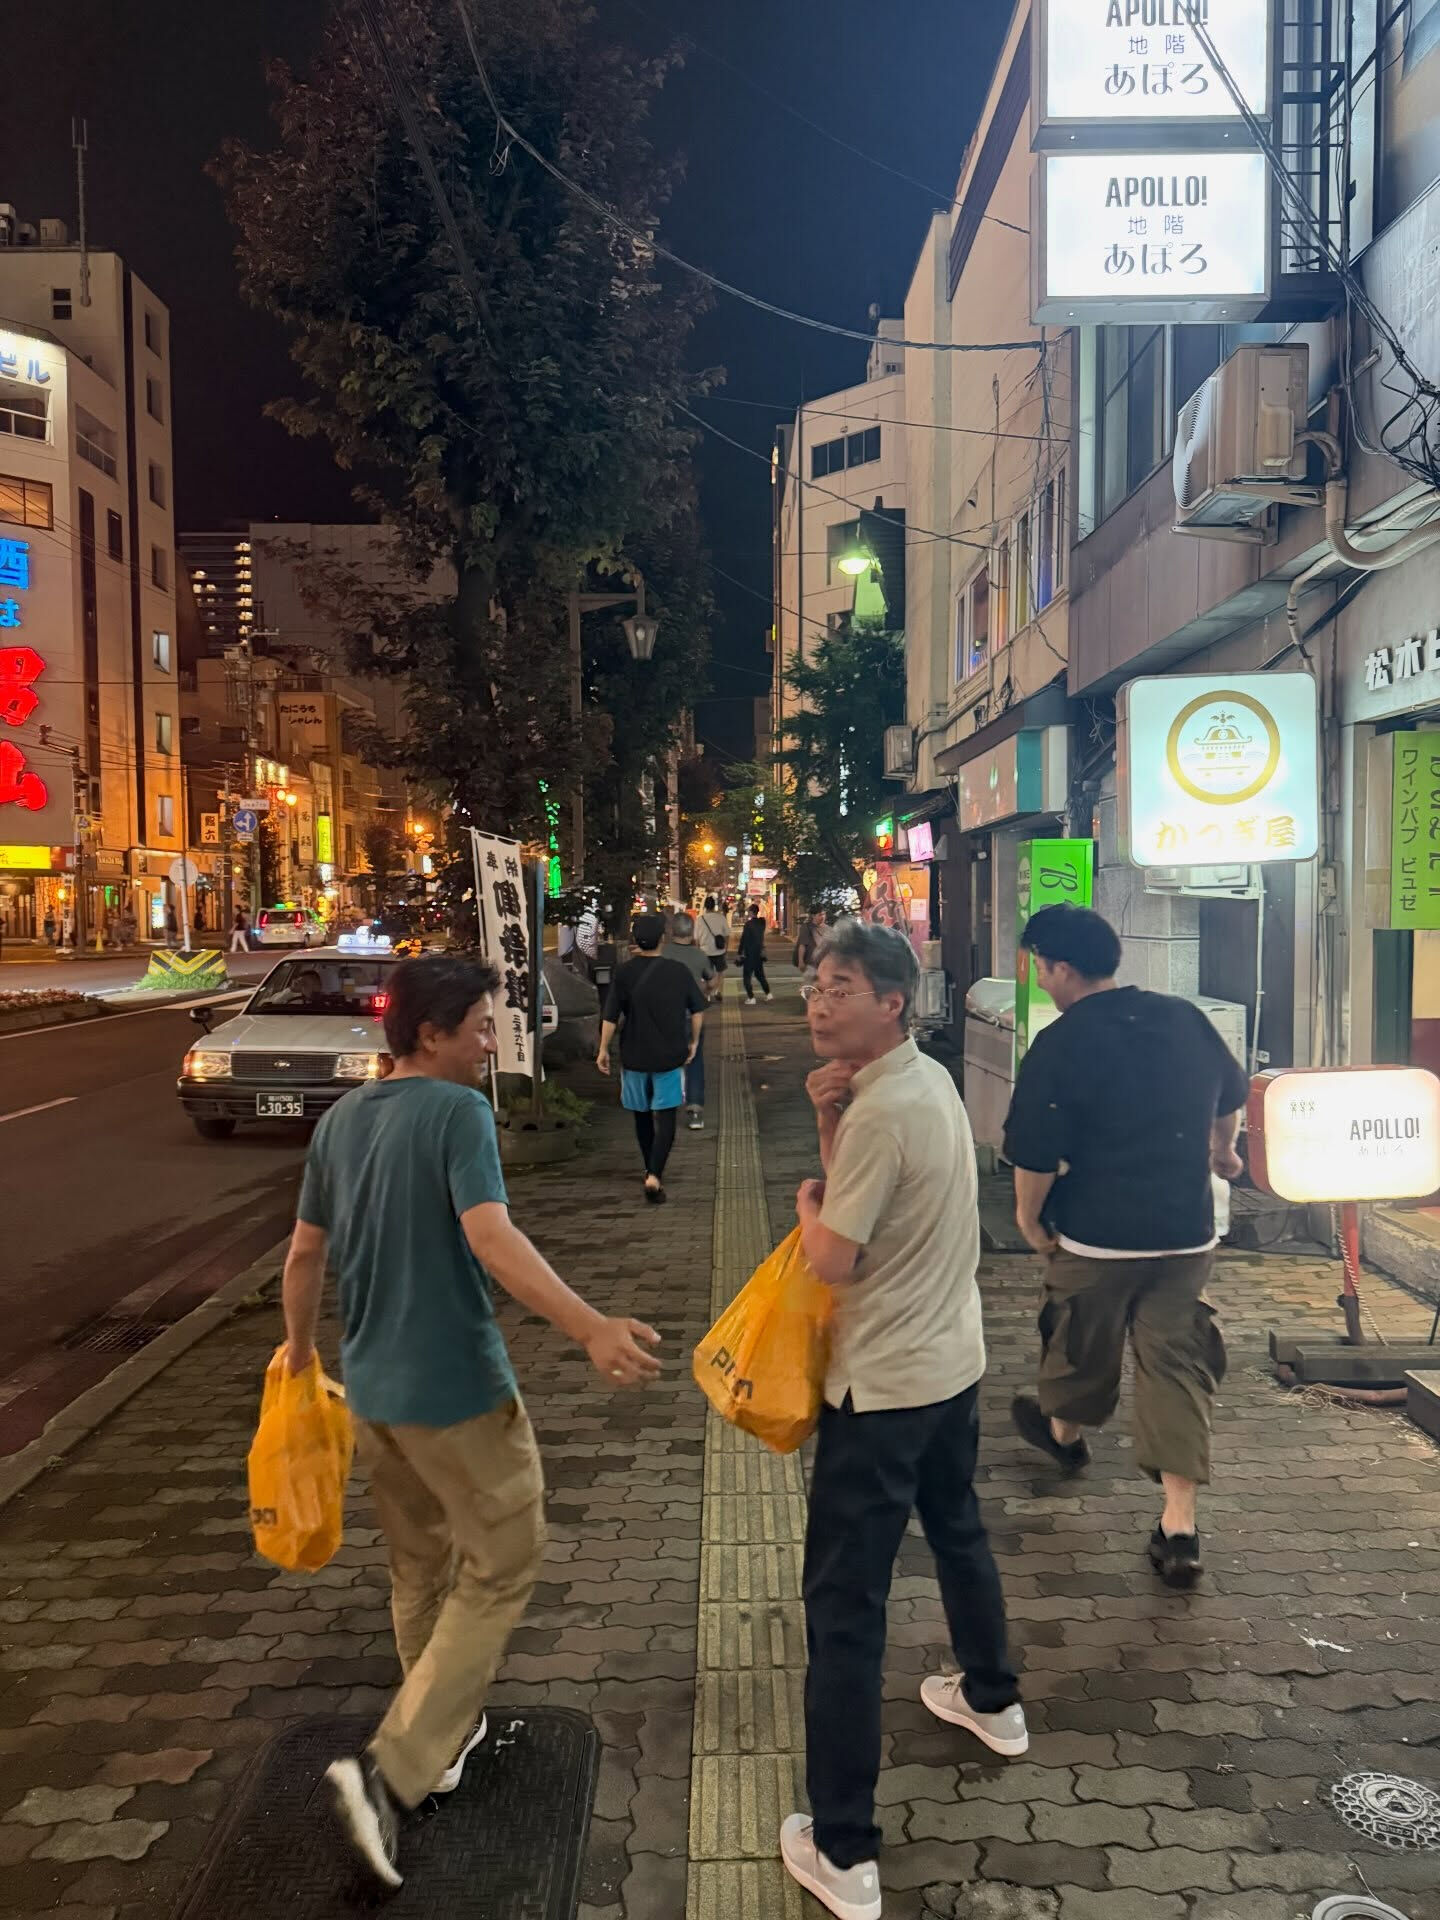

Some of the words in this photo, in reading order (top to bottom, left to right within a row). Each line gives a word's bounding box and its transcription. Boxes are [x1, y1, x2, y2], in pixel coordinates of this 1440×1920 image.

[1105, 0, 1208, 27] APOLLO!
[1104, 62, 1209, 96] あぽろ
[1105, 175, 1207, 208] APOLLO!
[1104, 242, 1208, 276] あぽろ
[1401, 749, 1419, 845] ワインパブ
[1400, 857, 1417, 911] ビュゼ
[267, 1102, 301, 1114] 30-95
[1349, 1116, 1421, 1141] APOLLO!
